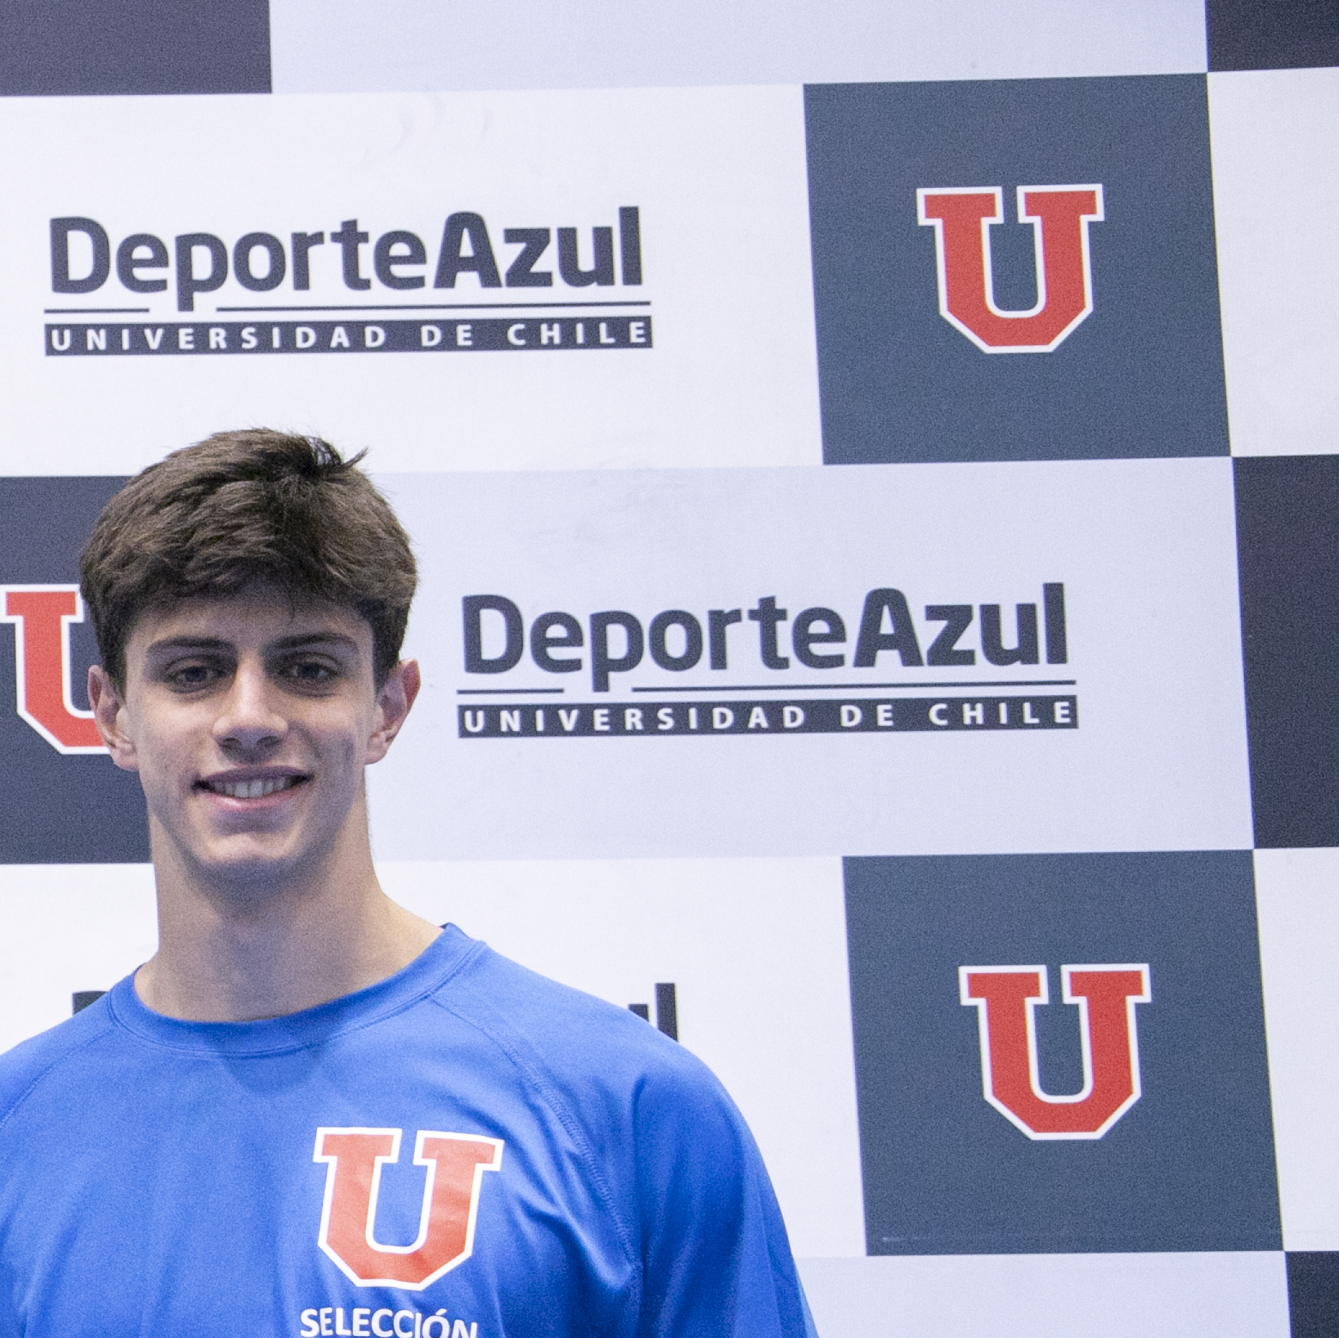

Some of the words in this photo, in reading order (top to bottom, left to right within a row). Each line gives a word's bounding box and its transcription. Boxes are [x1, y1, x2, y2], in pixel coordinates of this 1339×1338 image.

[49, 205, 643, 312] DeporteAzul
[916, 183, 1105, 354] U
[51, 325, 386, 352] UNIVERSIDAD
[421, 324, 473, 348] DE
[508, 321, 647, 347] CHILE
[462, 582, 1068, 692] DeporteAzul
[463, 705, 805, 734] UNIVERSIDAD
[840, 704, 894, 728] DE
[929, 701, 1071, 726] CHILE
[958, 963, 1152, 1140] U
[313, 1127, 504, 1291] U
